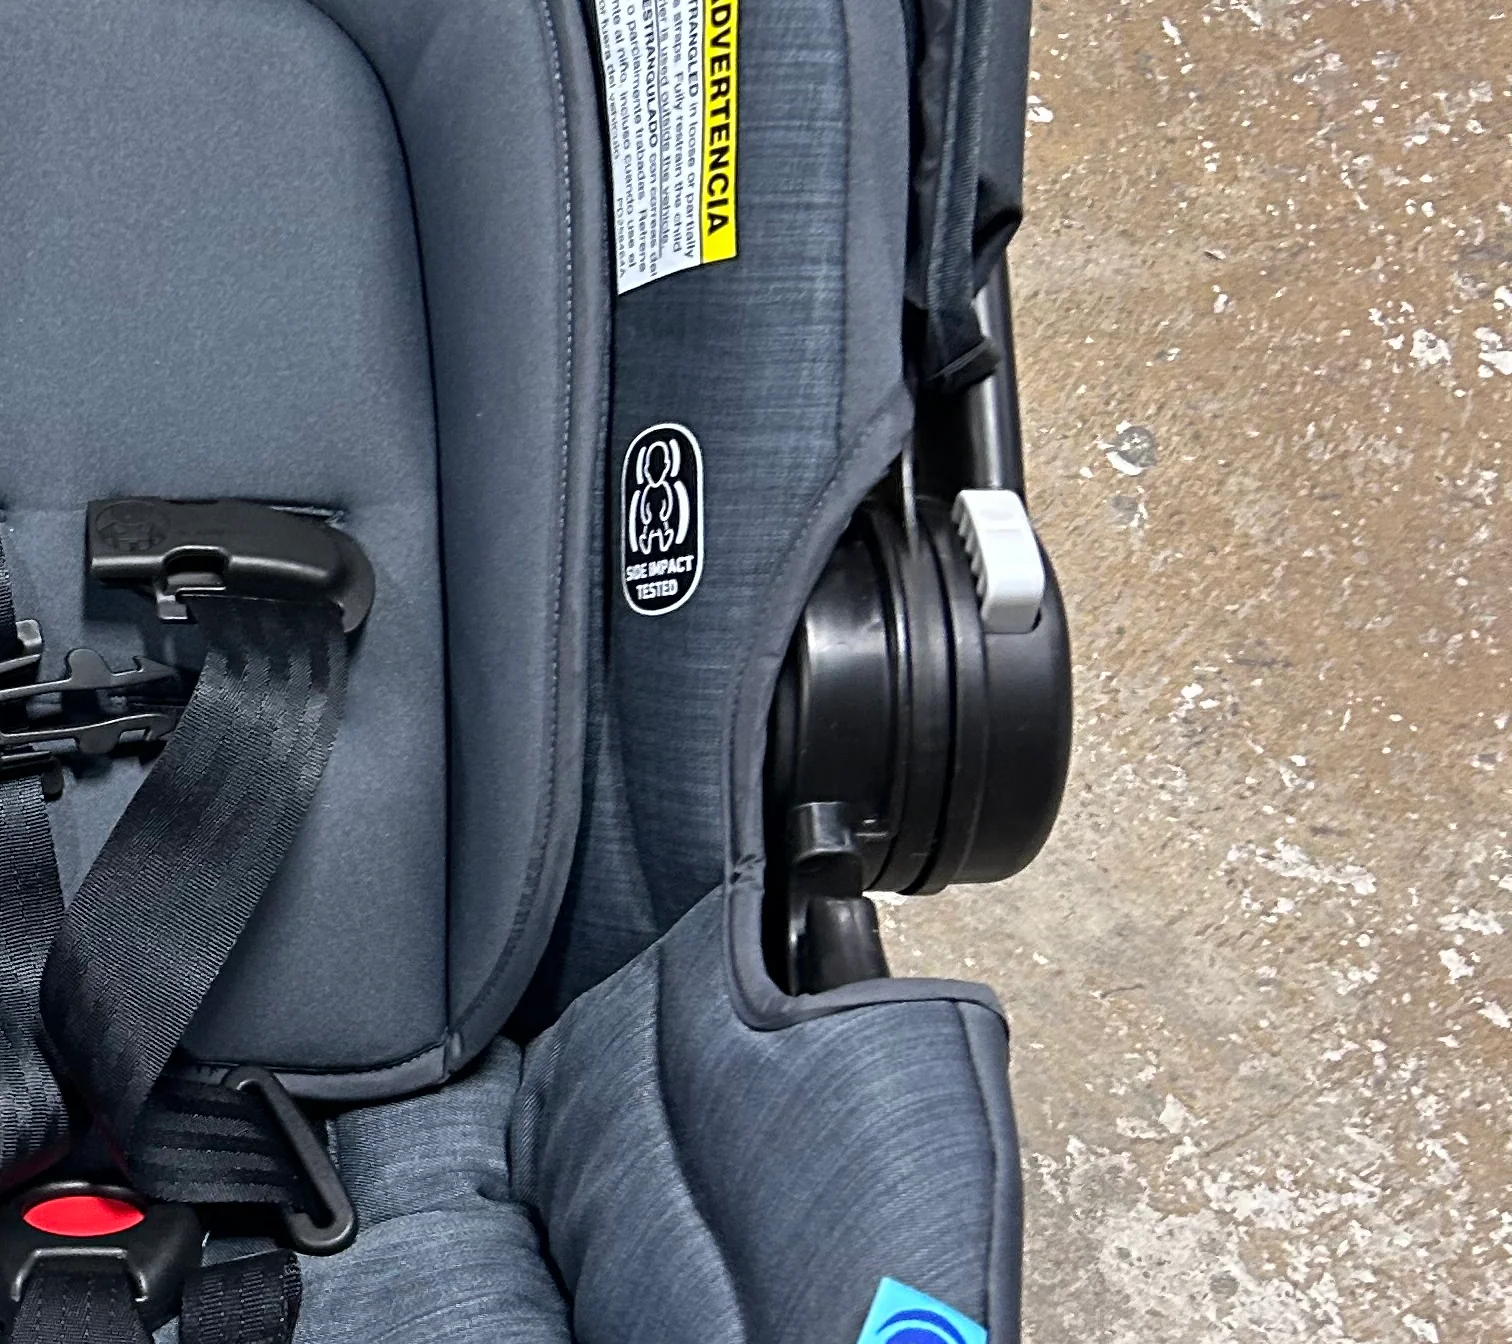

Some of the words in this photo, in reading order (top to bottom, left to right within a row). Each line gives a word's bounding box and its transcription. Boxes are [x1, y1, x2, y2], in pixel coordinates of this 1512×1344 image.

[626, 3, 635, 16] o
[613, 27, 625, 44] al
[659, 26, 669, 42] is
[607, 62, 616, 89] del
[625, 18, 644, 125] parcialmente
[659, 45, 669, 87] used
[672, 70, 685, 112] Fully
[618, 90, 631, 151] incluso
[660, 89, 671, 152] outside
[689, 101, 698, 118] in
[674, 114, 683, 178] restrain
[687, 120, 698, 168] loose
[623, 152, 635, 215] cuando
[648, 152, 657, 184] con
[661, 155, 671, 183] the
[687, 171, 695, 189] or
[673, 180, 683, 209] the
[648, 185, 658, 248] correas
[672, 210, 682, 253] child
[683, 191, 696, 260] partially
[626, 218, 635, 249] use
[627, 251, 637, 268] el
[649, 250, 658, 277] del
[625, 562, 648, 582] SIDE
[648, 555, 695, 576] IMPACT
[636, 578, 679, 600] TESTED
